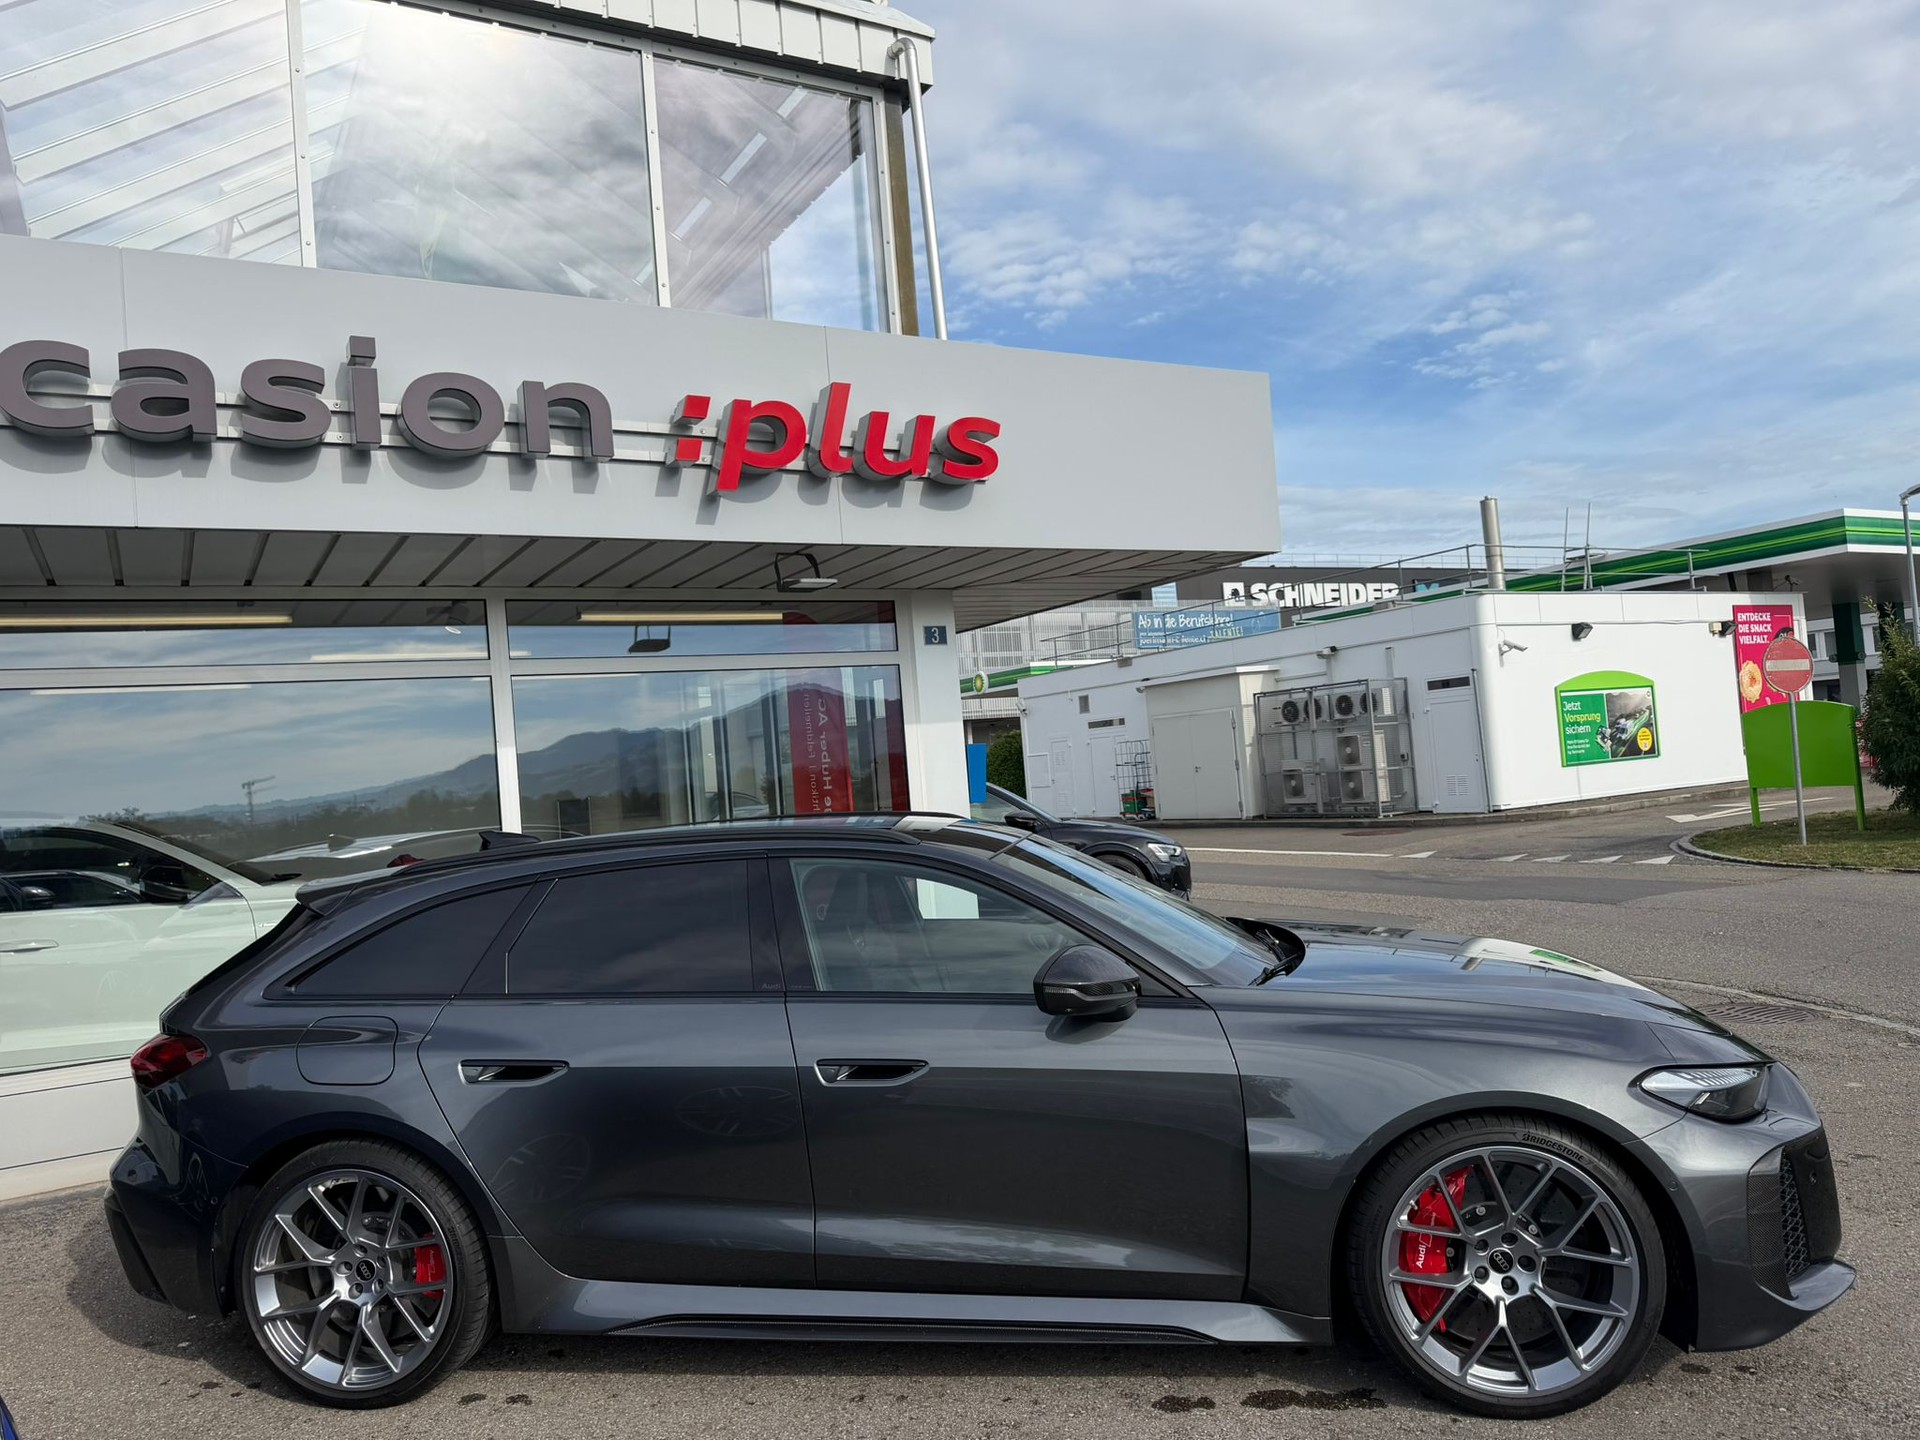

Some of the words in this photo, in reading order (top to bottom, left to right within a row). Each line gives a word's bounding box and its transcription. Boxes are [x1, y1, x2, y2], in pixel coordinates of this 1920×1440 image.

[1250, 582, 1400, 607] SCHNEIDER
[1138, 614, 1151, 628] Ab
[1153, 614, 1162, 628] in
[1737, 612, 1771, 621] ENTDECKE
[1738, 624, 1750, 633] DIE
[1750, 623, 1772, 632] SNACK
[931, 628, 940, 643] 3
[1739, 635, 1770, 644] VIELFALT.
[1563, 701, 1581, 711] Jetzt
[1564, 712, 1601, 723] Vorsprung
[1565, 724, 1591, 734] sichern
[1521, 1131, 1585, 1162] BRIDGESTONE
[1415, 1244, 1426, 1269] Audi
